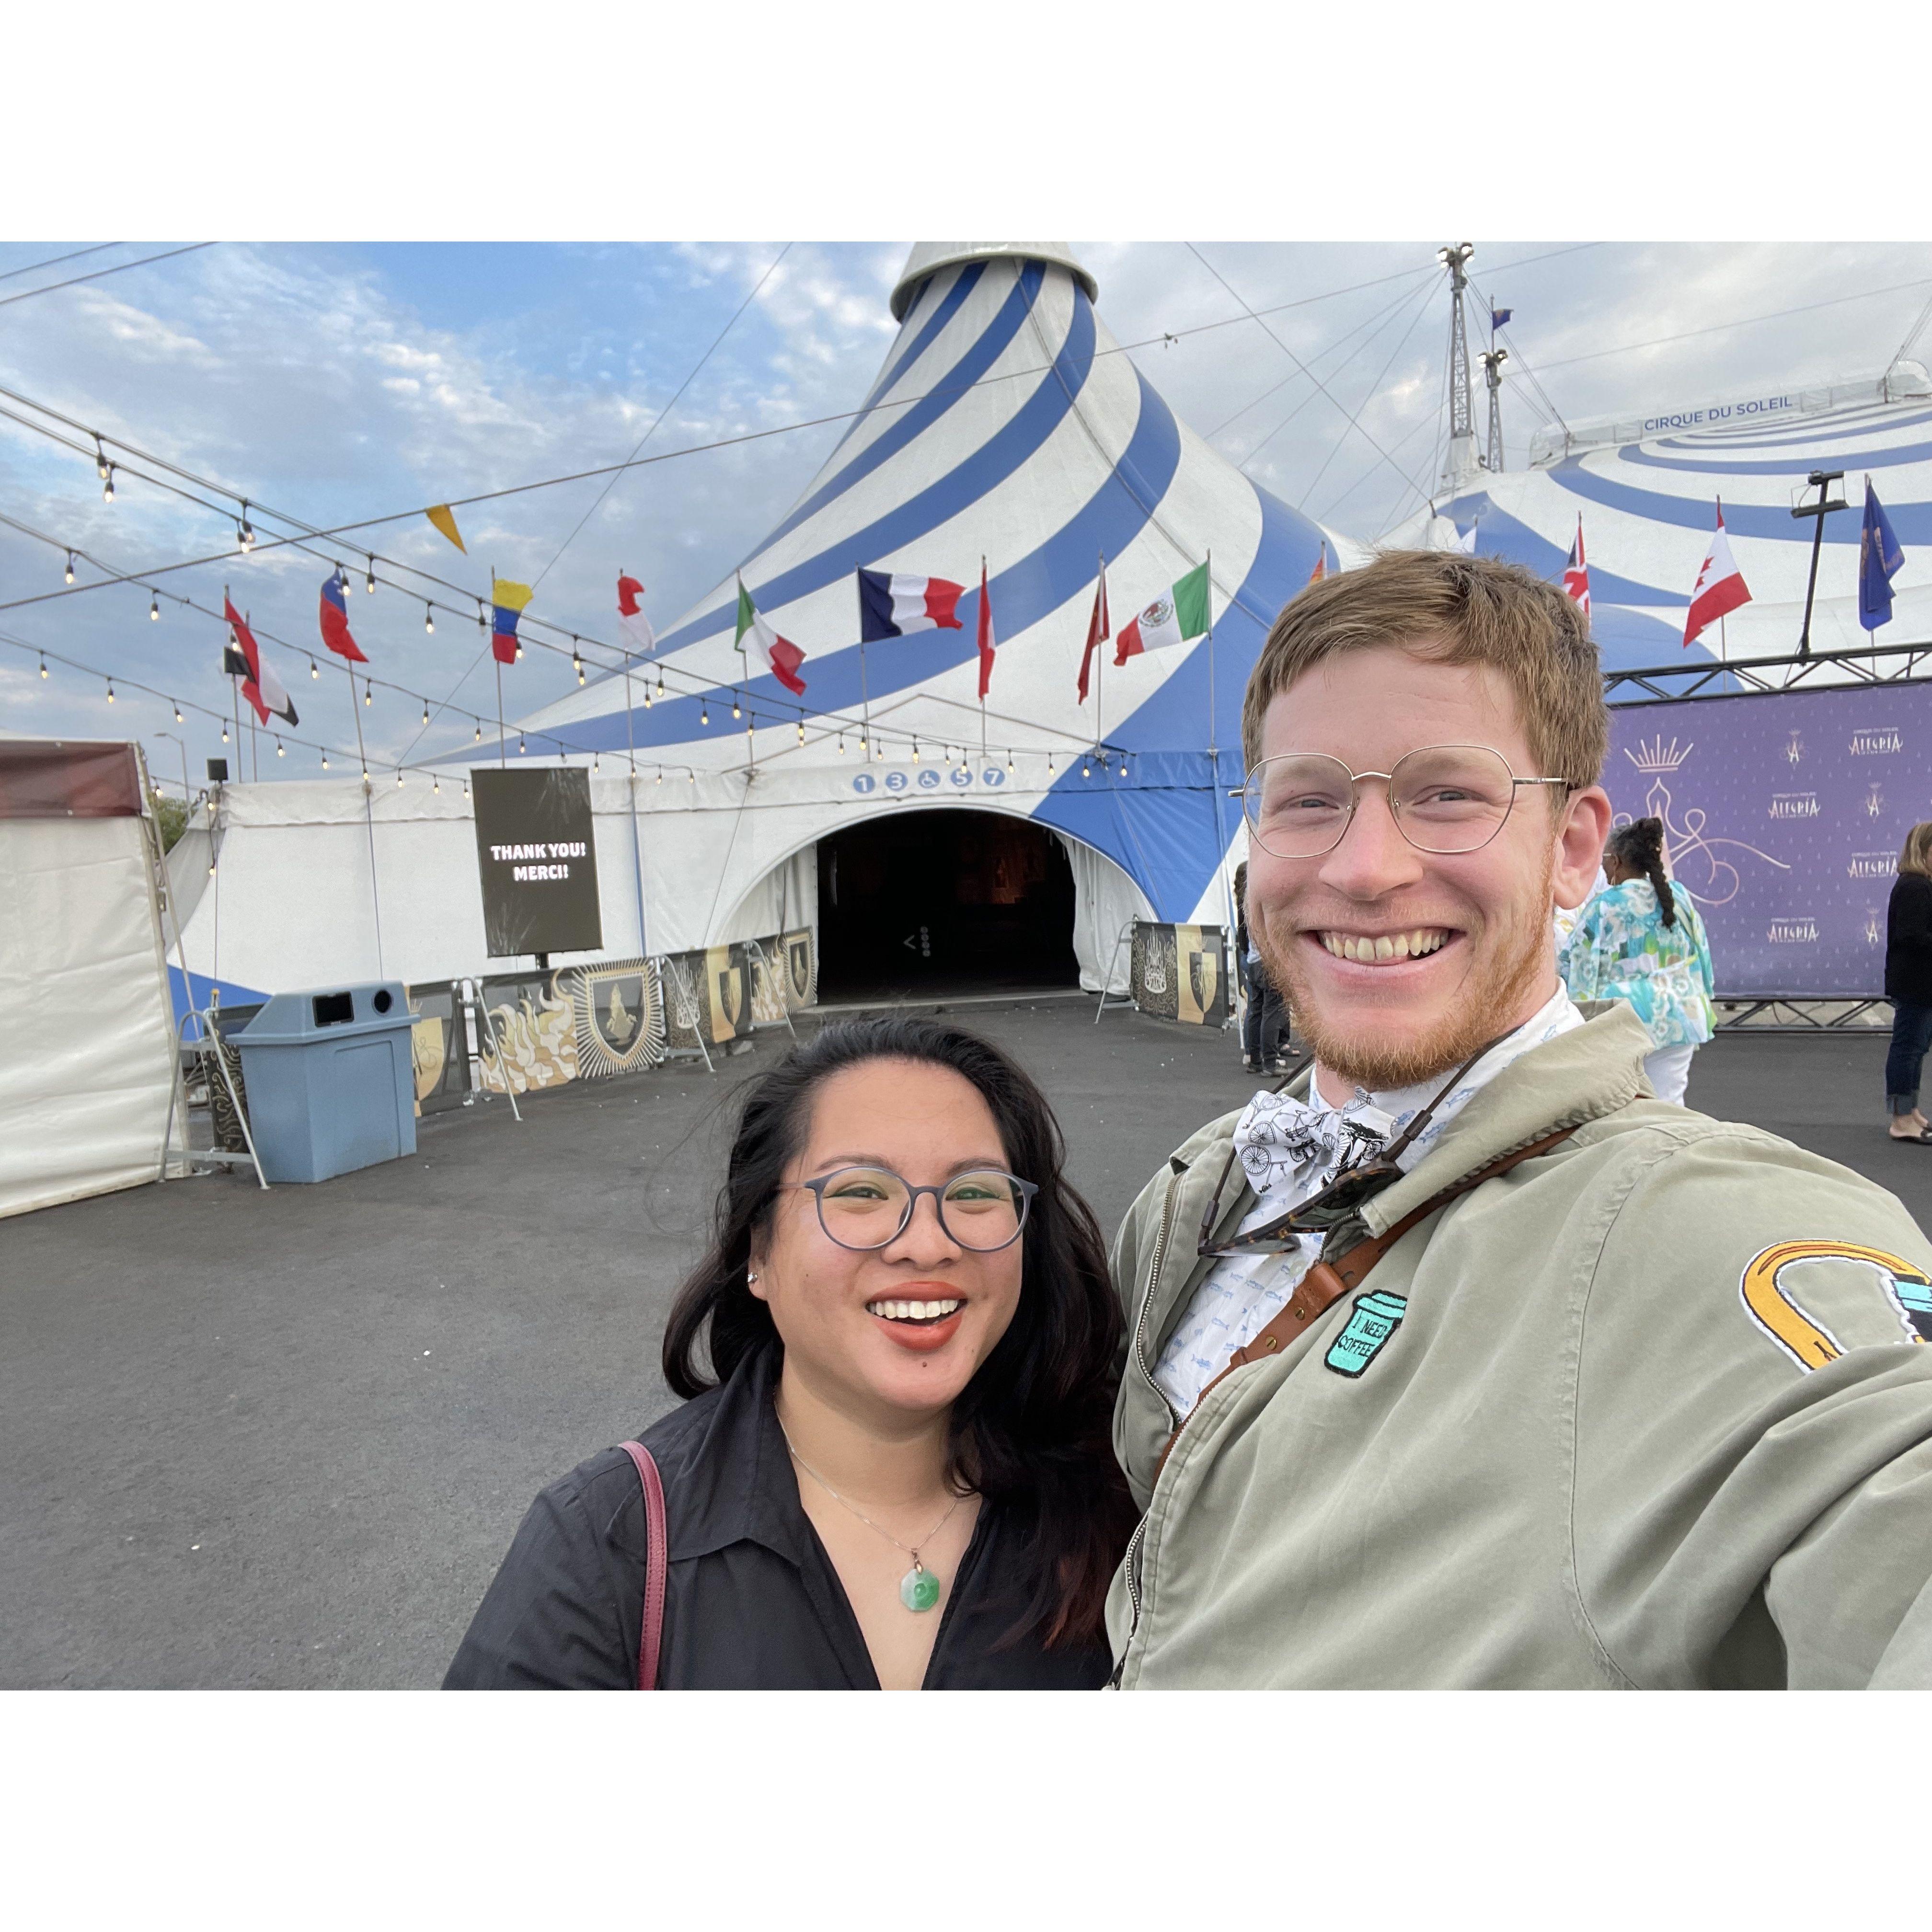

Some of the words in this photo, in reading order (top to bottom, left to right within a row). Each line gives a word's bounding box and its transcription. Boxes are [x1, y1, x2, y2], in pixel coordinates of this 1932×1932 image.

[1644, 411, 1703, 431] CIRQUE
[1709, 406, 1731, 421] DU
[1736, 396, 1793, 415] SOLEIL
[858, 778, 868, 791] 1
[891, 774, 903, 788] 3
[957, 769, 968, 785] 5
[987, 770, 1000, 784] 7
[490, 844, 546, 861] THANK
[548, 842, 586, 858] YOU!
[513, 864, 569, 881] MERCI!
[1352, 1310, 1363, 1328] I
[1360, 1319, 1388, 1339] NEED
[1337, 1335, 1376, 1357] COFFEE
